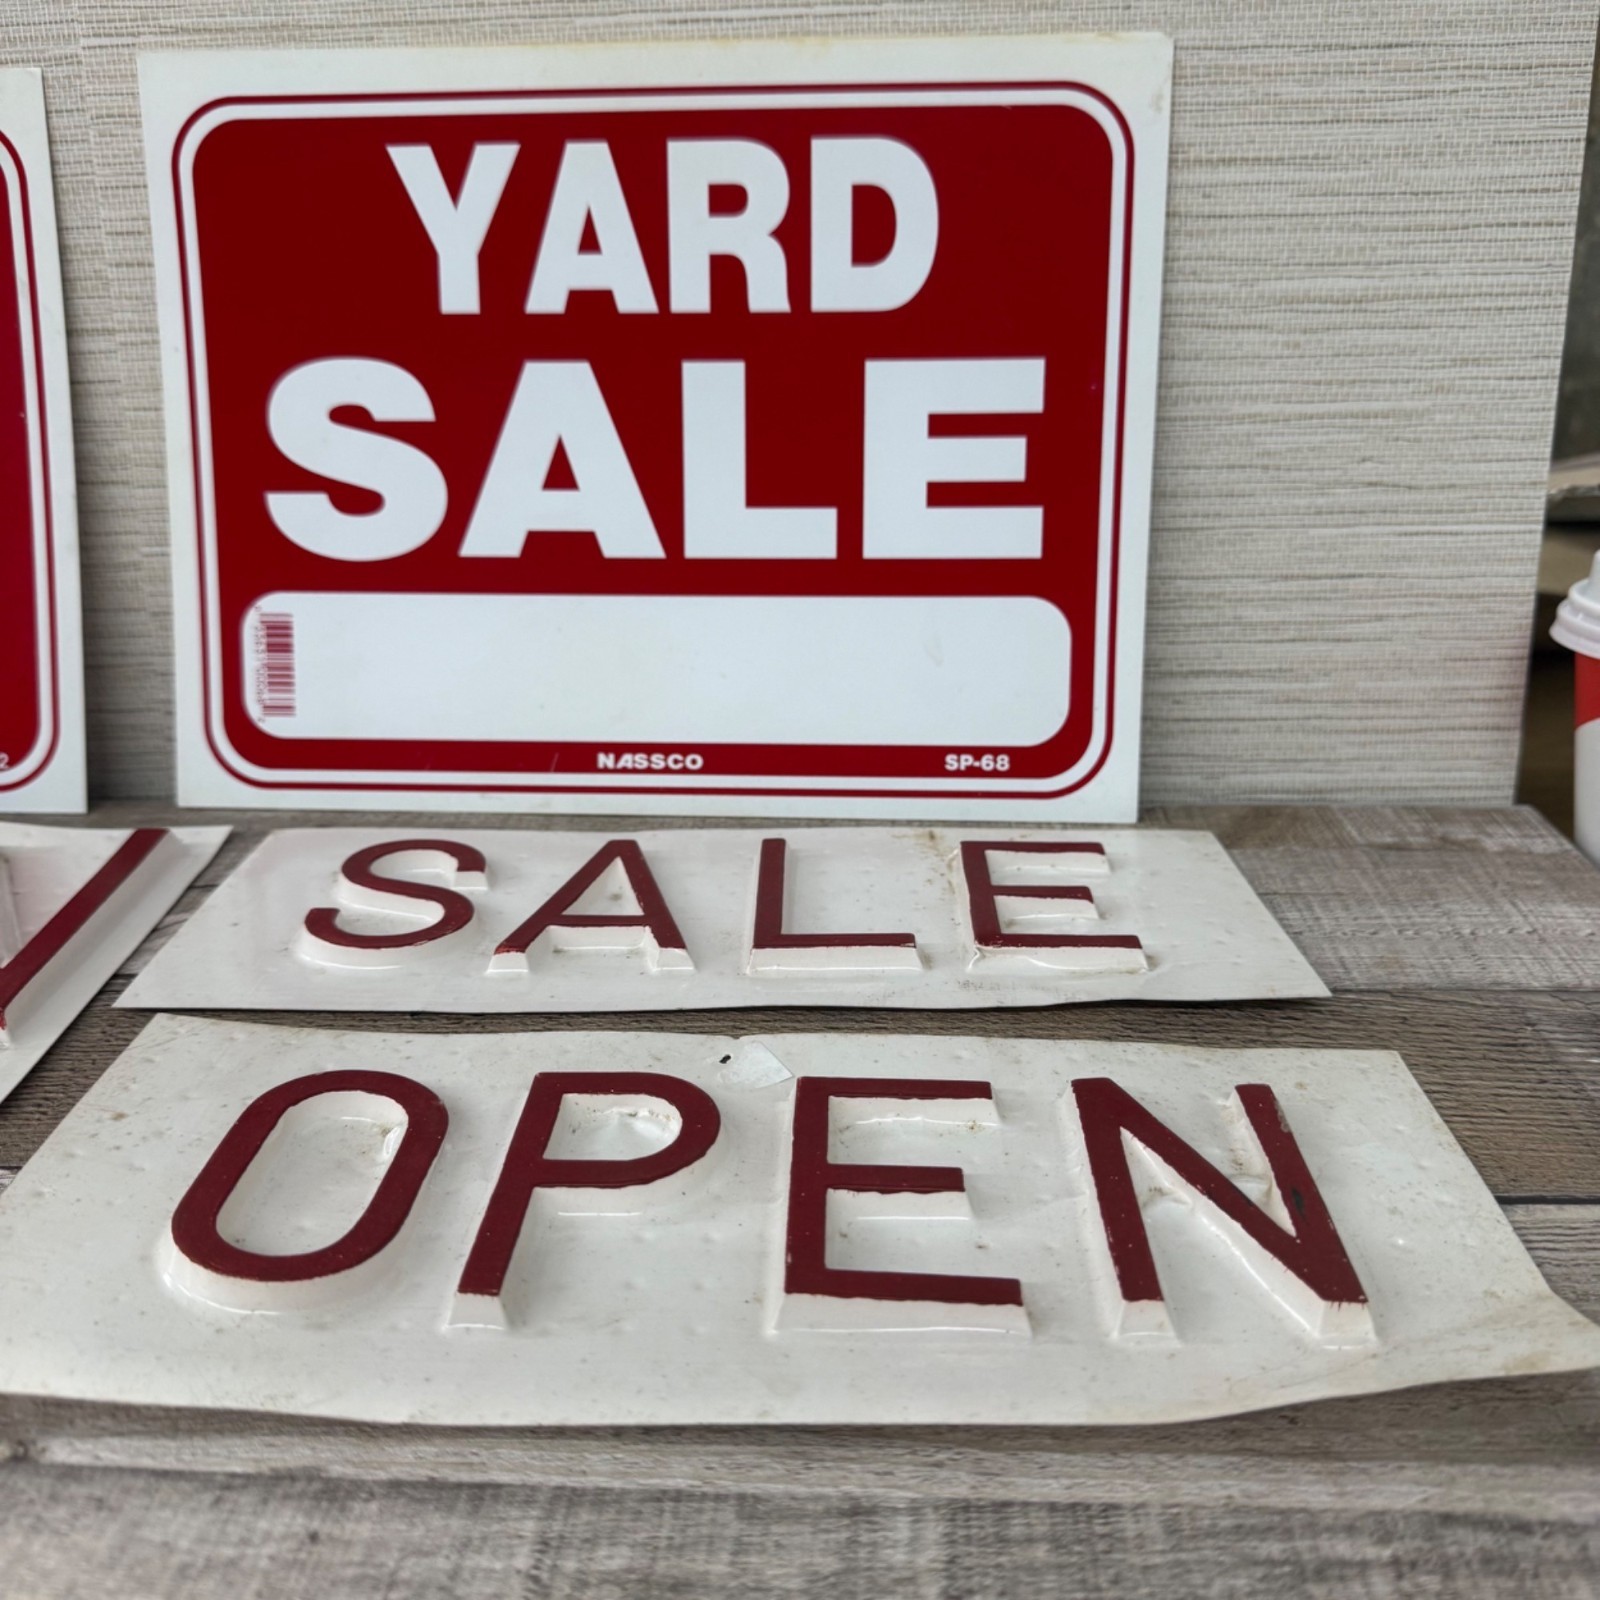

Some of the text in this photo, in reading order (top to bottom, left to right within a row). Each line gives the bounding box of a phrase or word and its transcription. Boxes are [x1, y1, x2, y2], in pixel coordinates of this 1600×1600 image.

[386, 136, 939, 315] YARD
[265, 357, 1046, 562] SALE
[597, 752, 704, 770] NASSCO
[944, 753, 1010, 772] SP-68
[305, 838, 1140, 952] SALE
[172, 1069, 1367, 1305] OPEN
